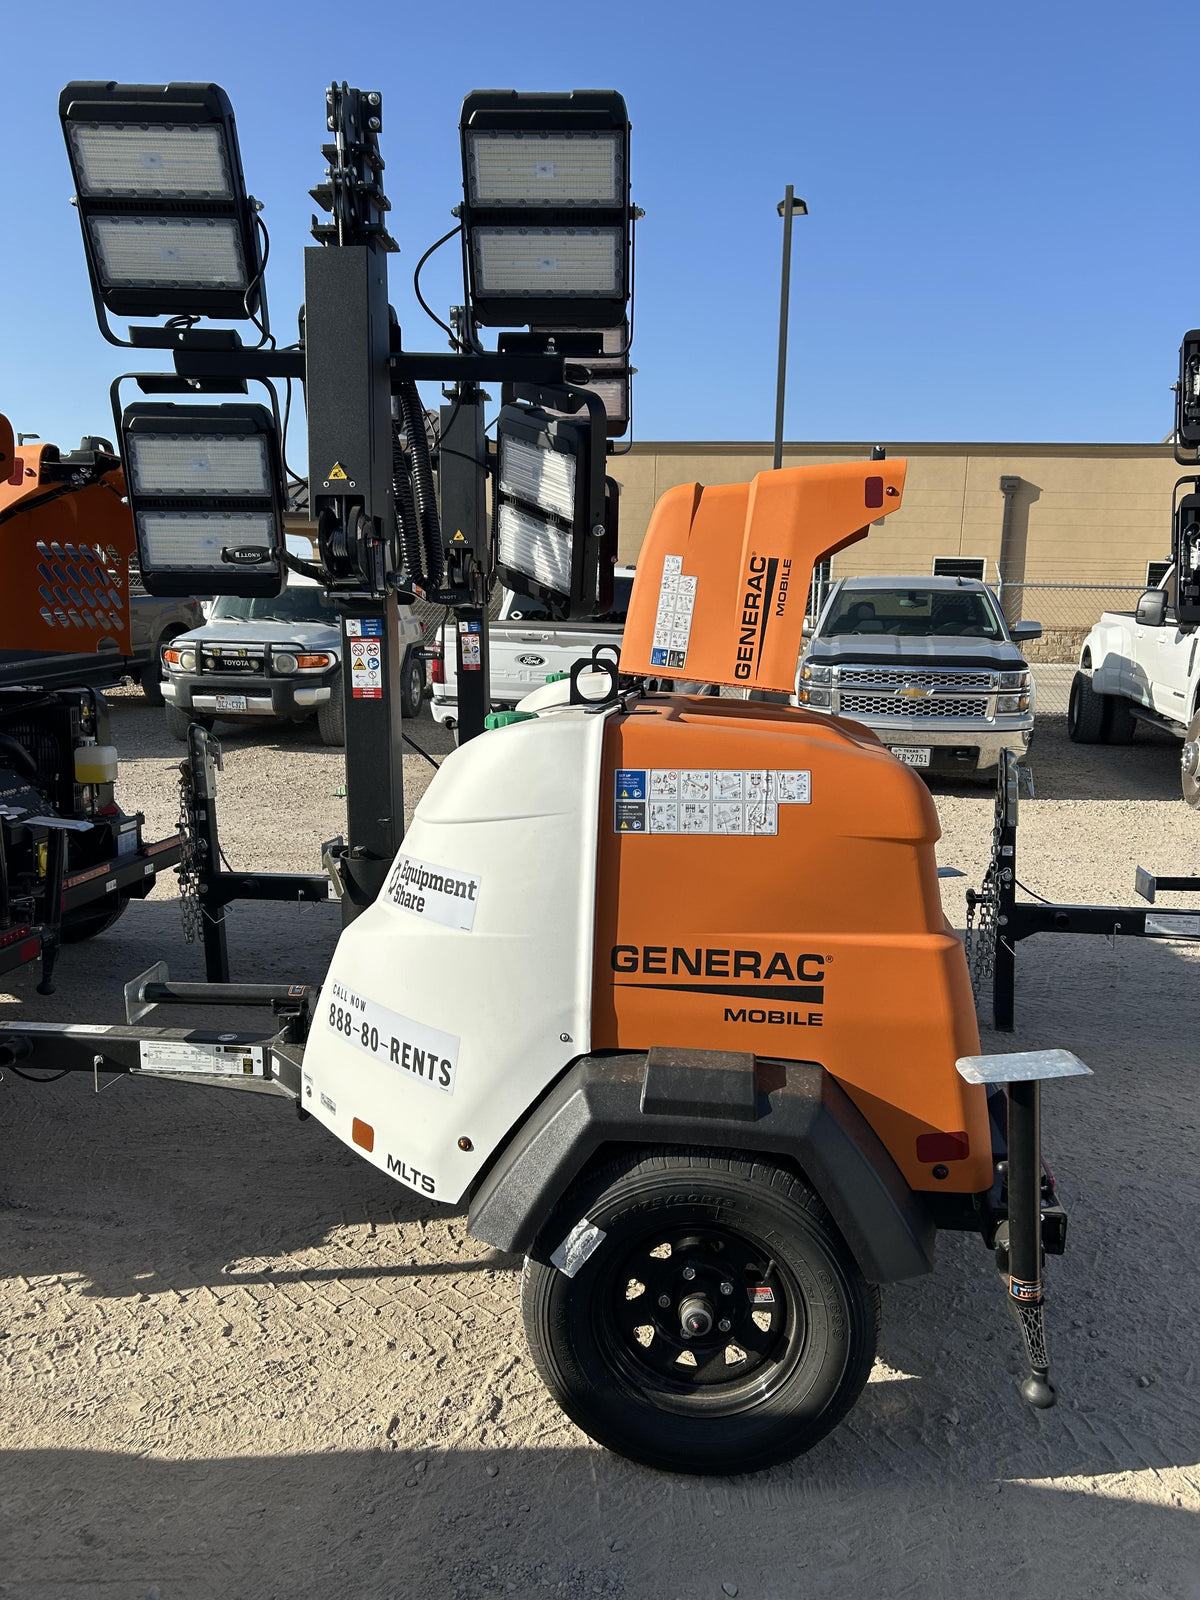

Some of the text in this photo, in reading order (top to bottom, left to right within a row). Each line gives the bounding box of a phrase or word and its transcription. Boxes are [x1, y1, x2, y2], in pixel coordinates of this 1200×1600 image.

[776, 559, 792, 616] MOBILE
[223, 659, 250, 667] TOYOTA
[522, 655, 542, 665] Ford
[400, 859, 478, 901] Equipment
[393, 883, 426, 913] Share
[332, 983, 367, 1012] CALL NOW
[724, 1008, 824, 1026] MOBILE
[328, 1002, 452, 1087] 888-80-RENTS
[387, 1153, 436, 1194] MLTS
